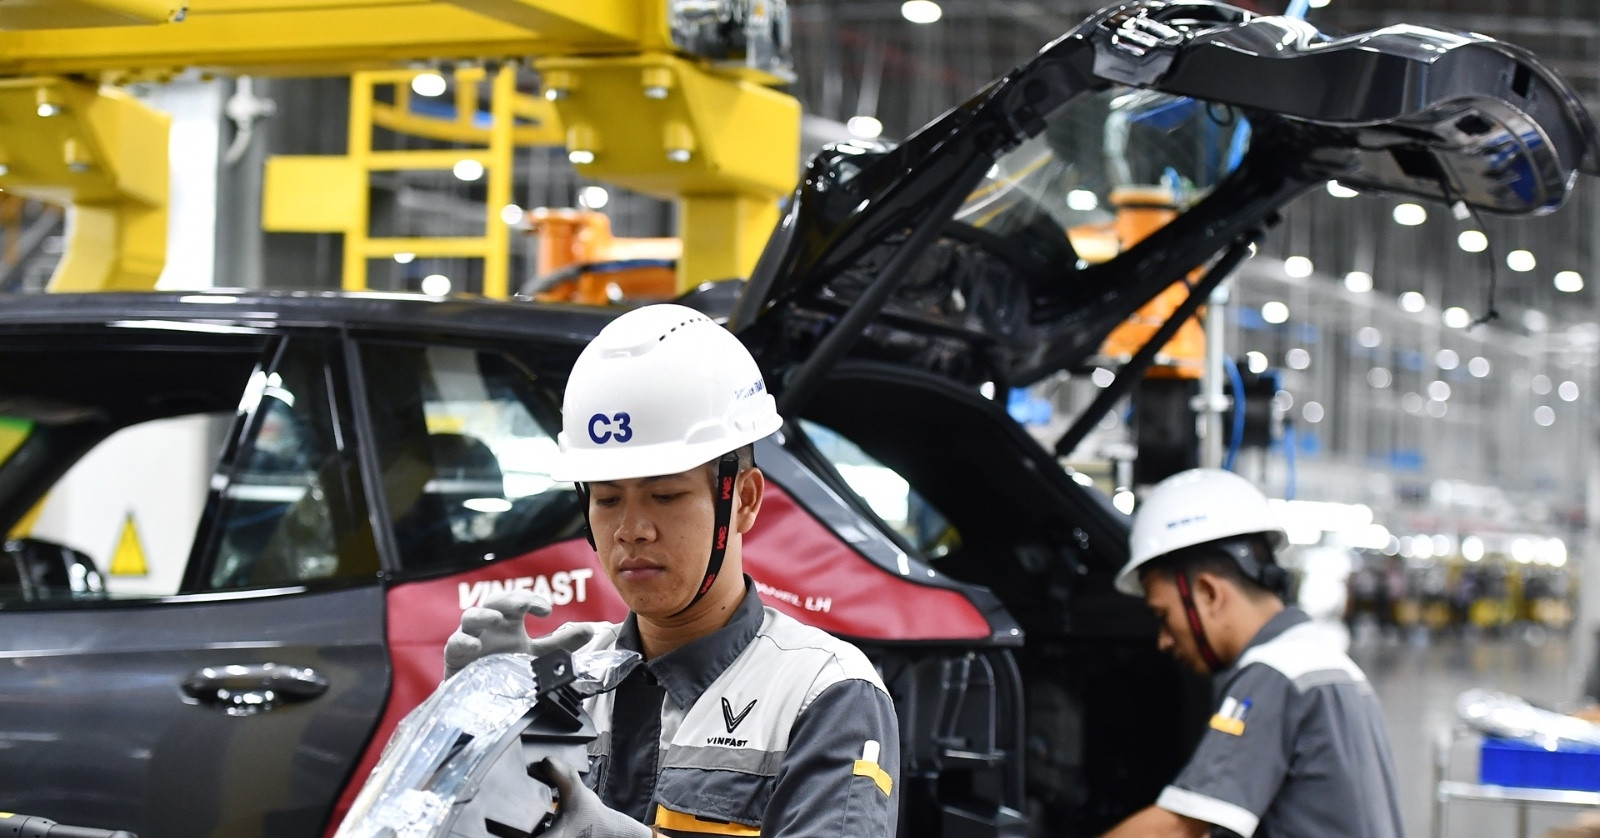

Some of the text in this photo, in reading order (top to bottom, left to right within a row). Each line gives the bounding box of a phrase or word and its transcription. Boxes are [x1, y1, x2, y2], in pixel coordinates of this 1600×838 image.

[588, 411, 633, 445] C3
[722, 476, 732, 501] 3M
[717, 526, 727, 550] 3M
[706, 736, 748, 747] VINFAST
